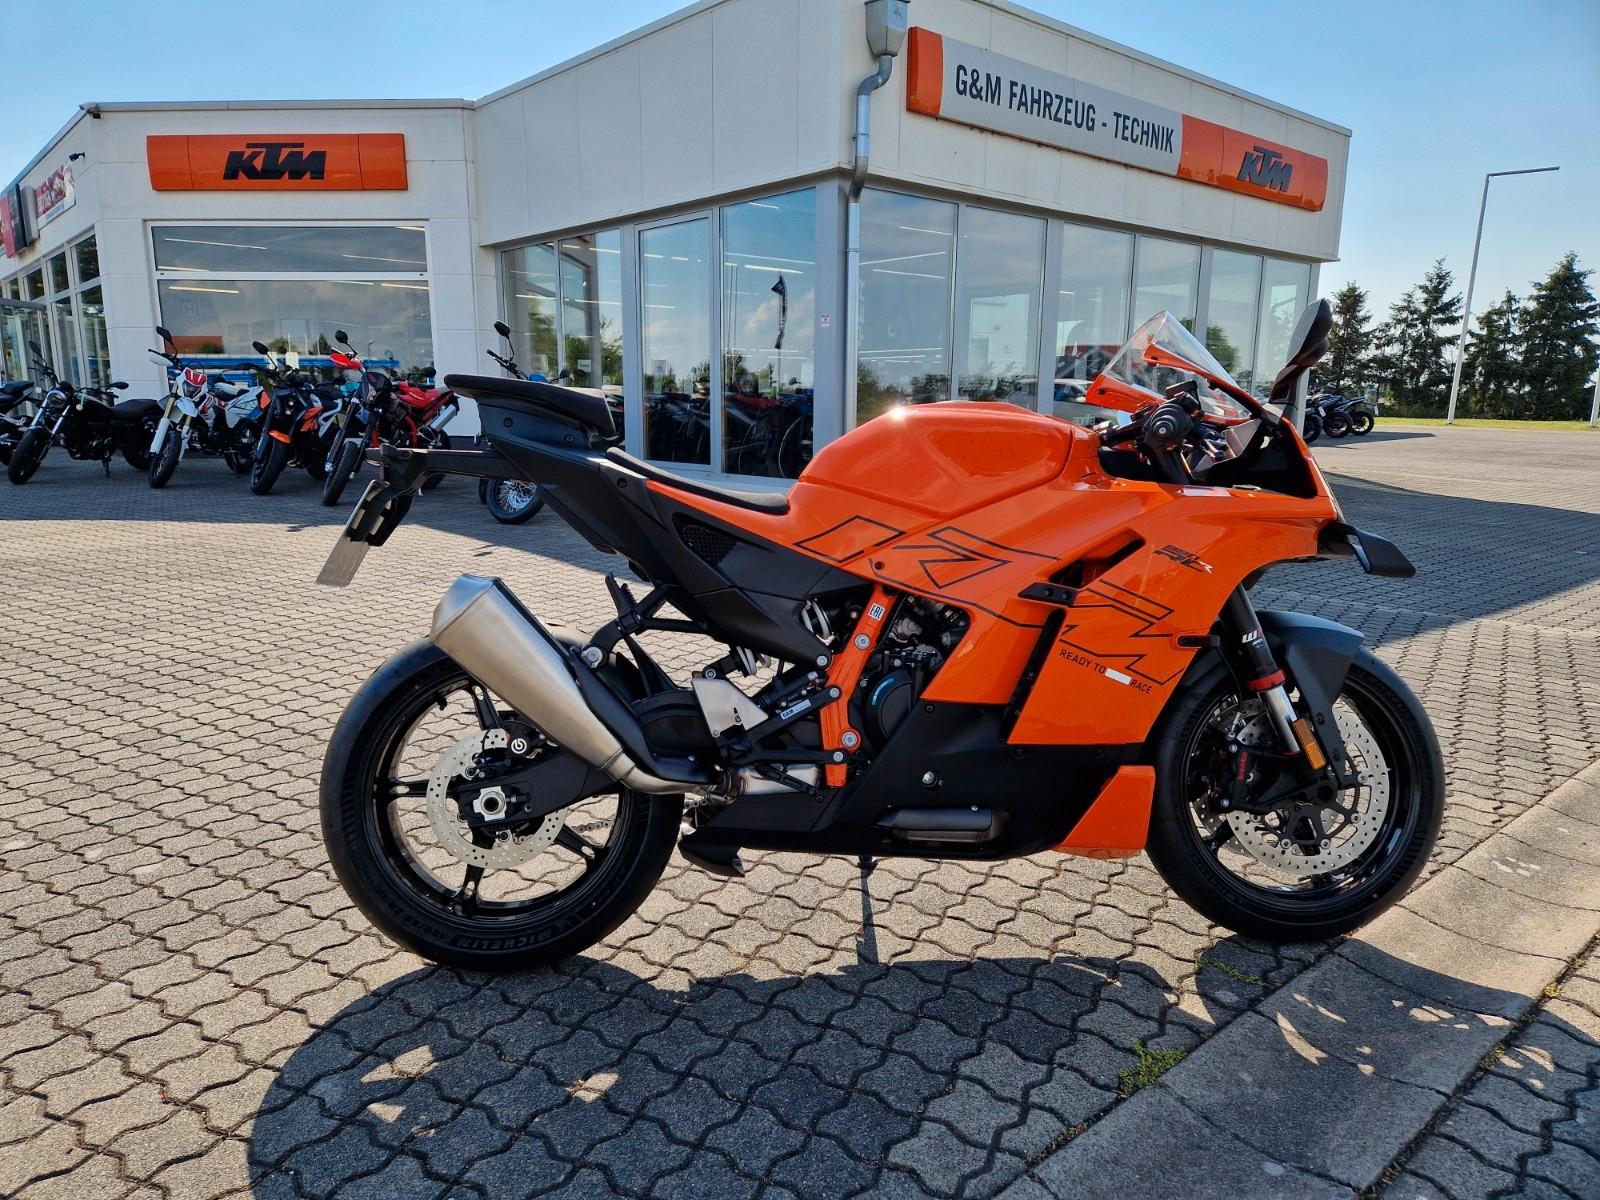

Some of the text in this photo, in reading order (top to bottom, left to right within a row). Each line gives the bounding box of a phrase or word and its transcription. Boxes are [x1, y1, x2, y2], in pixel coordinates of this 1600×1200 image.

[956, 64, 1001, 106] G&M
[1008, 80, 1096, 132] FAHRZEUG
[1113, 112, 1174, 153] TECHNIK
[222, 142, 327, 180] KTM
[1237, 145, 1293, 192] KTM
[1059, 648, 1153, 694] READY TO RACE
[456, 927, 554, 949] MICHELIN
